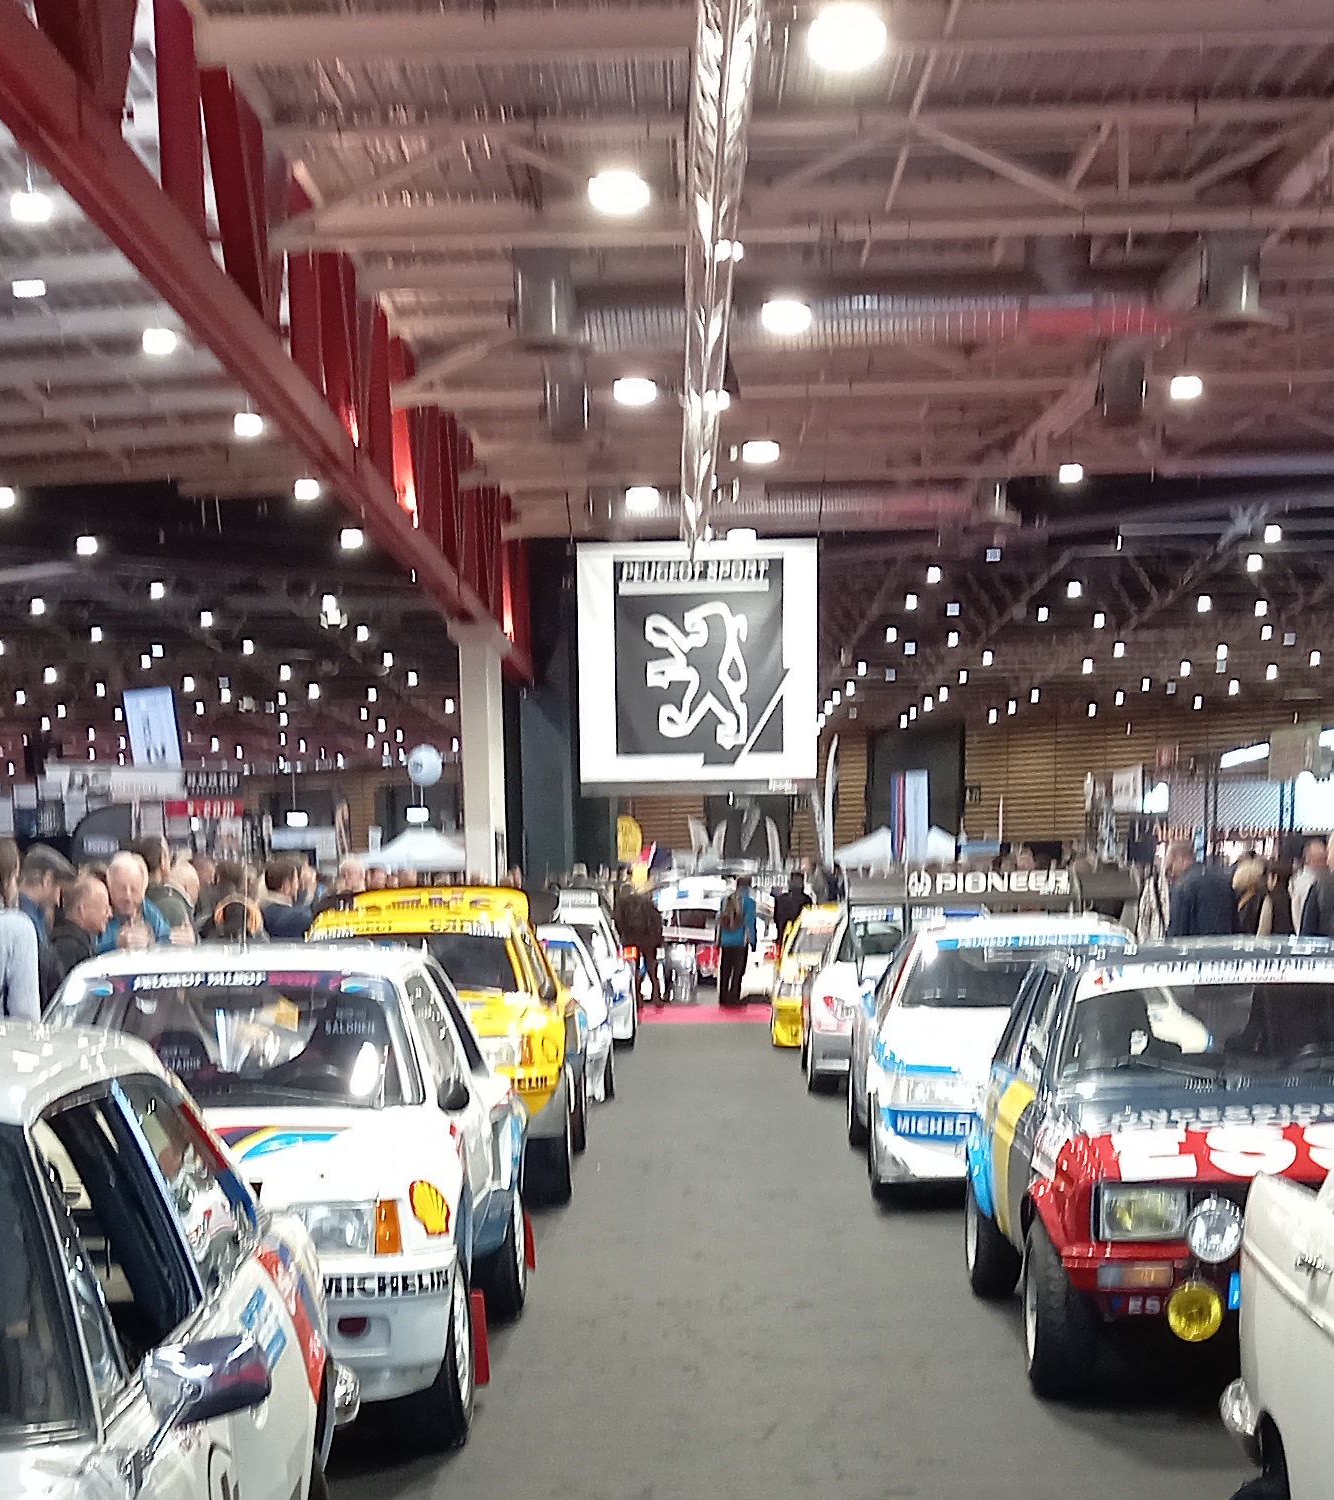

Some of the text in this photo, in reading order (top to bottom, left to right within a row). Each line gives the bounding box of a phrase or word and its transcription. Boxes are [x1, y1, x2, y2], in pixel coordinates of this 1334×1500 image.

[622, 559, 770, 583] PEUGEOT SPORT
[935, 869, 1070, 894] PIONEER
[322, 1269, 449, 1299] MICHELIN
